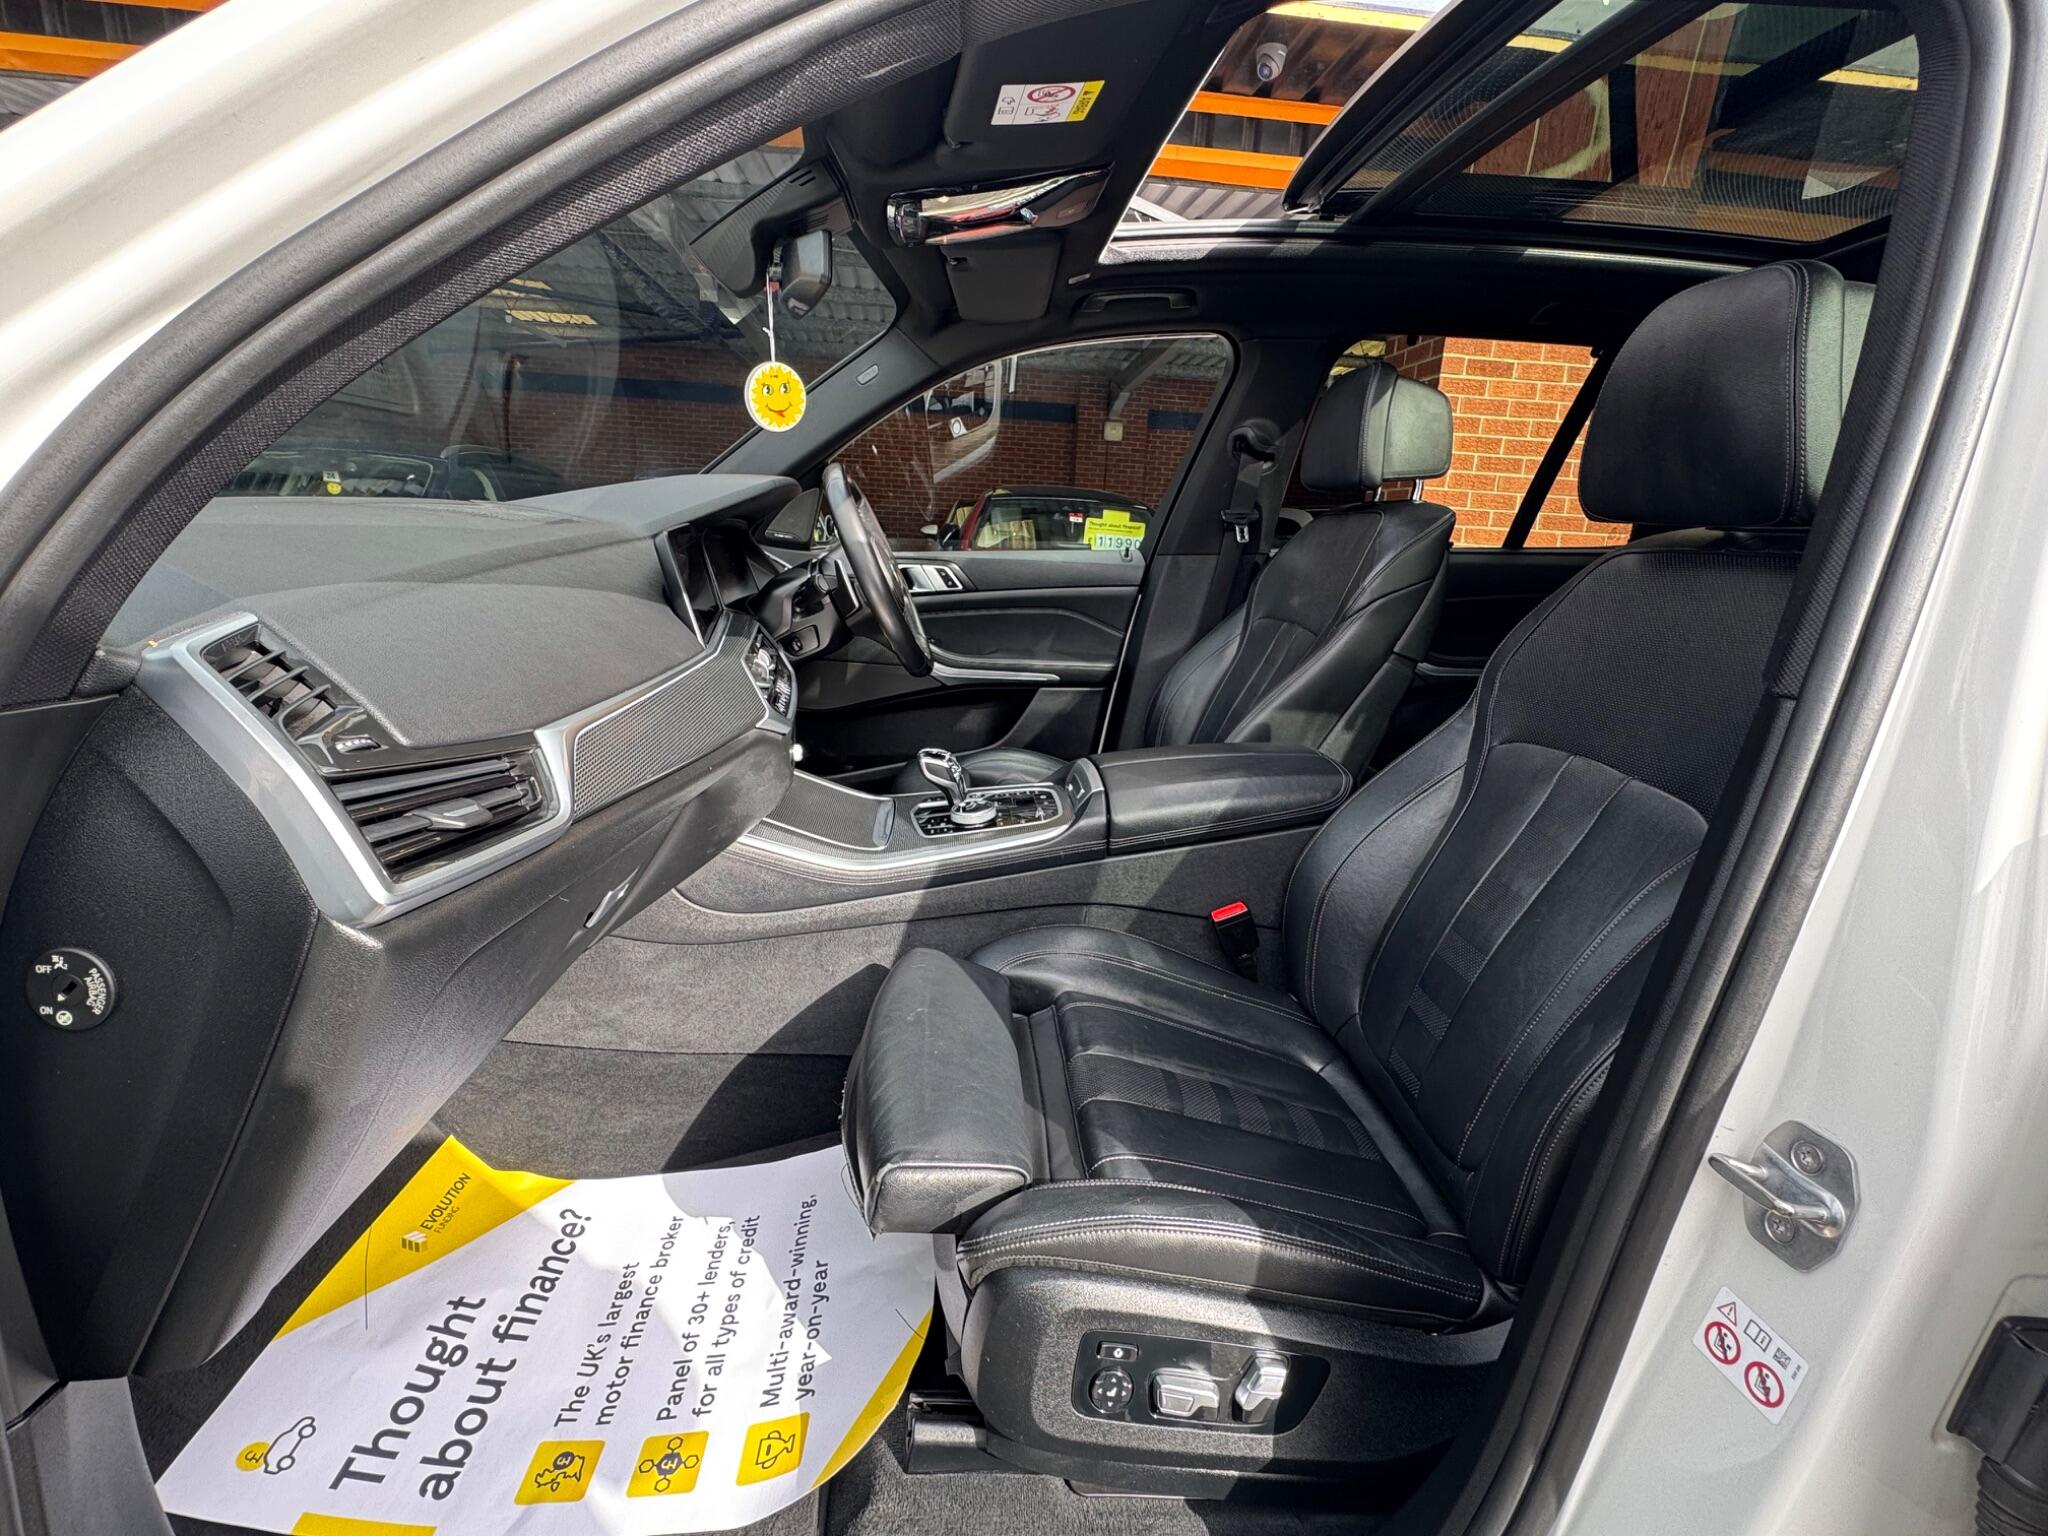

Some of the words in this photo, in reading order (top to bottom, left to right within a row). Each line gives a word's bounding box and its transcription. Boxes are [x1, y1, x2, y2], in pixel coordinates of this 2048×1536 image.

[35, 965, 53, 974] OFF
[89, 968, 107, 1015] PASSENGER
[39, 1006, 54, 1015] ON
[419, 1172, 471, 1230] EVOLUTION
[434, 1206, 460, 1234] FUNDING
[704, 1220, 736, 1286] lenders,
[738, 1215, 761, 1265] credit
[730, 1270, 746, 1289] of
[759, 1194, 818, 1407] Multi-award-winning,
[596, 1355, 633, 1426] motor
[621, 1273, 662, 1350] finance
[649, 1216, 684, 1269] broker
[688, 1291, 708, 1325] 30+
[715, 1294, 741, 1348] types
[796, 1259, 831, 1400] year-on-year
[419, 1358, 517, 1501] about
[492, 1208, 592, 1344] finance?
[554, 1385, 590, 1427] The
[581, 1333, 612, 1378] UK's
[605, 1261, 640, 1330] largest
[683, 1332, 699, 1351] of
[707, 1346, 726, 1377] all
[329, 1295, 486, 1491] Thought
[657, 1355, 692, 1421] Panel
[692, 1385, 717, 1418] for
